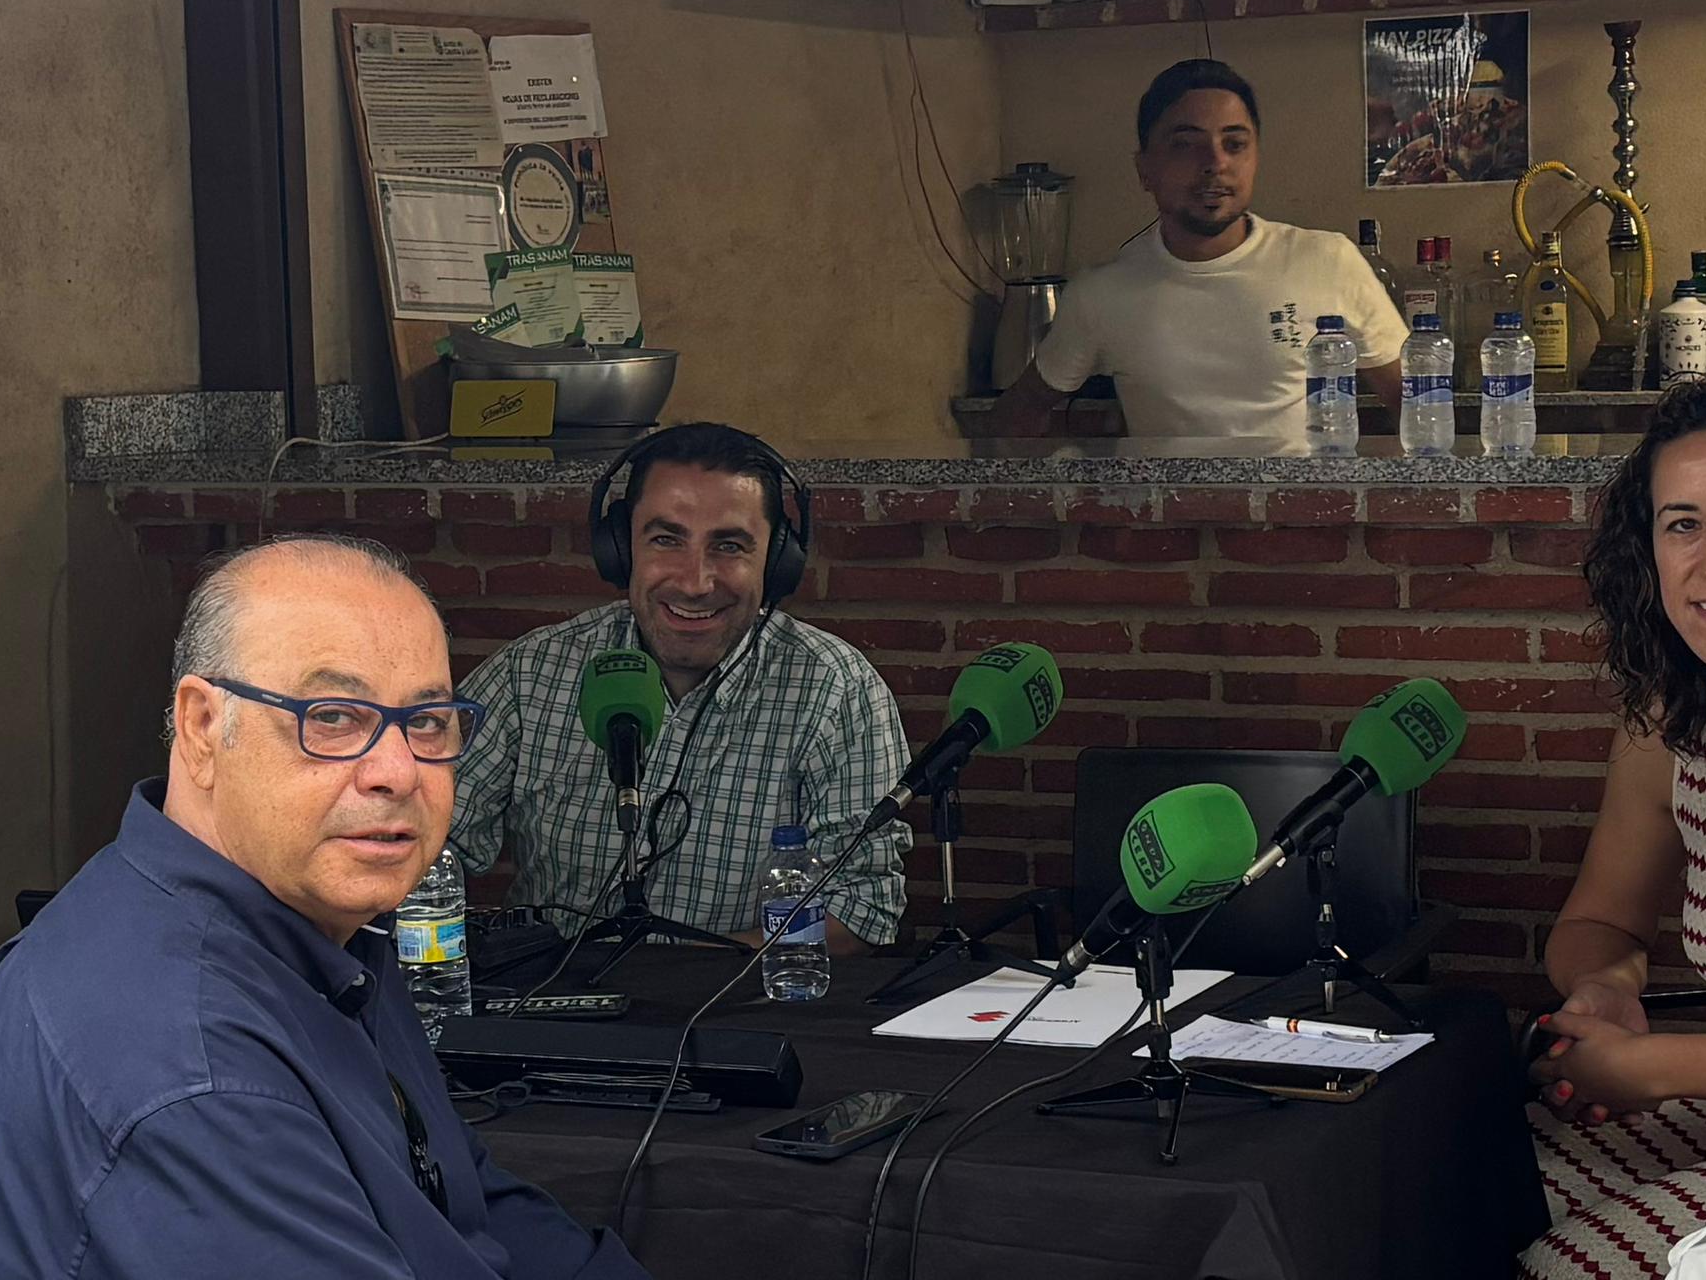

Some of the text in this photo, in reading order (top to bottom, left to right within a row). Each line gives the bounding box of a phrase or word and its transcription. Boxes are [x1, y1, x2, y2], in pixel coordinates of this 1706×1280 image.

[1416, 28, 1454, 47] PIZZ
[506, 250, 569, 268] TRASANAM
[573, 255, 632, 268] TRASANAM
[1131, 833, 1153, 878] CERO
